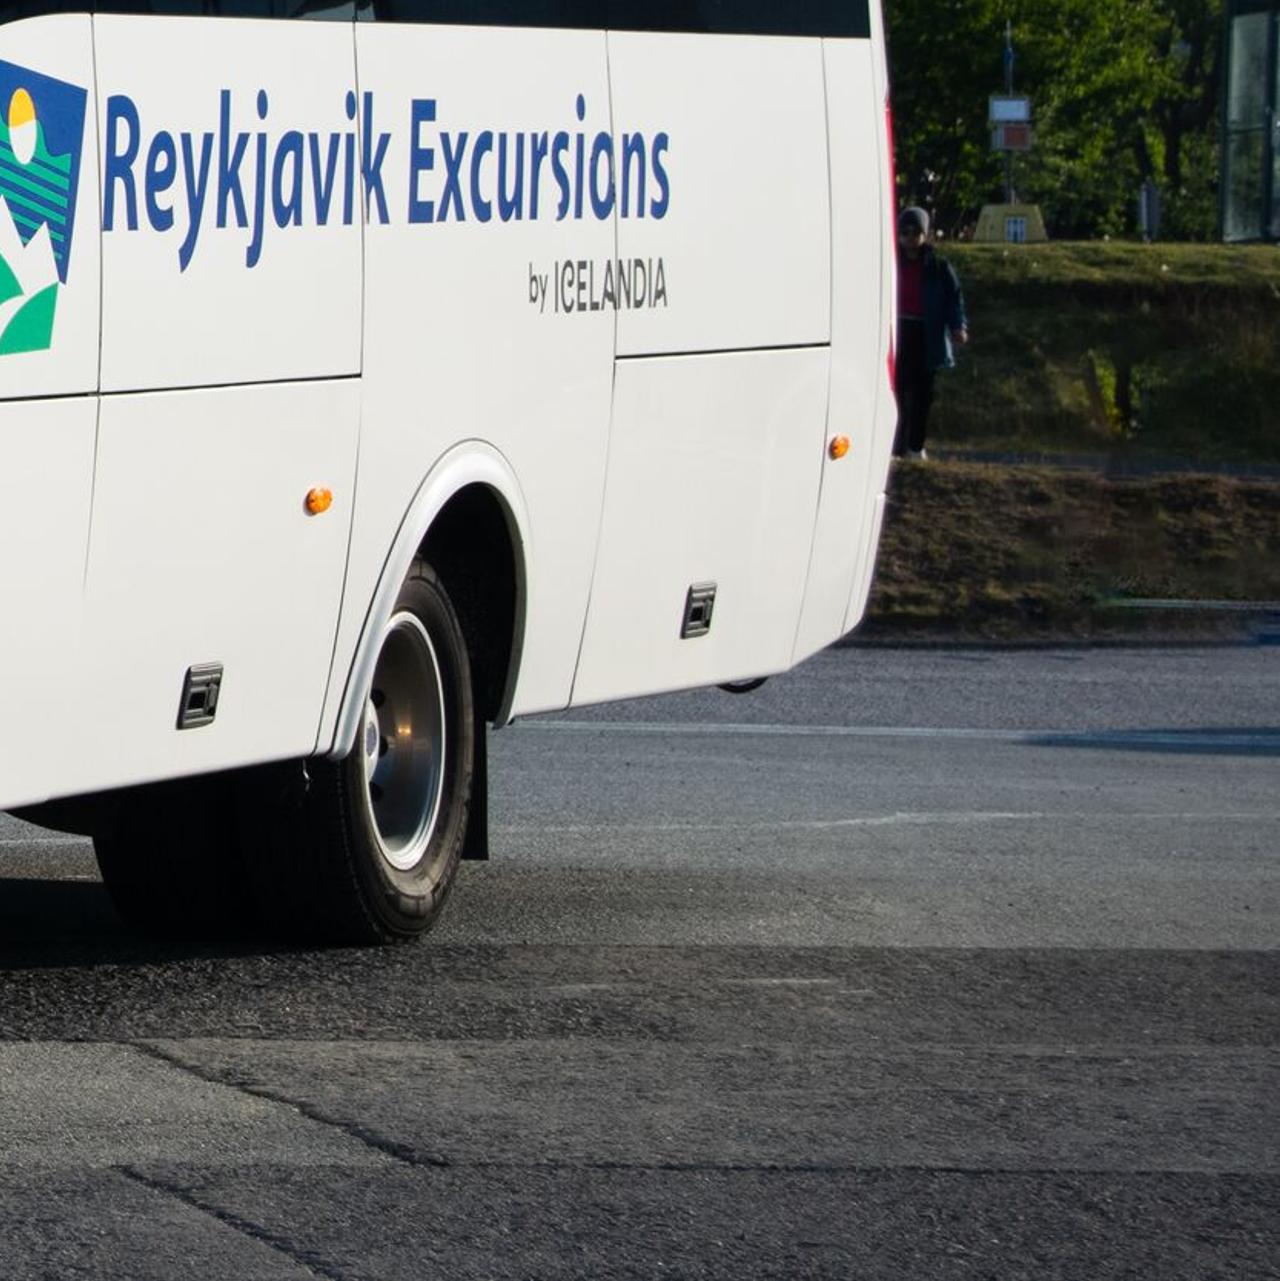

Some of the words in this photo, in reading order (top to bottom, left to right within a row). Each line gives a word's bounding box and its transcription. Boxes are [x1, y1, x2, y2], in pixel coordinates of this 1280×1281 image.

[101, 89, 391, 273] Reykjavik
[407, 93, 671, 225] Excursions
[528, 263, 548, 313] by
[554, 256, 669, 313] ICELANDIA
